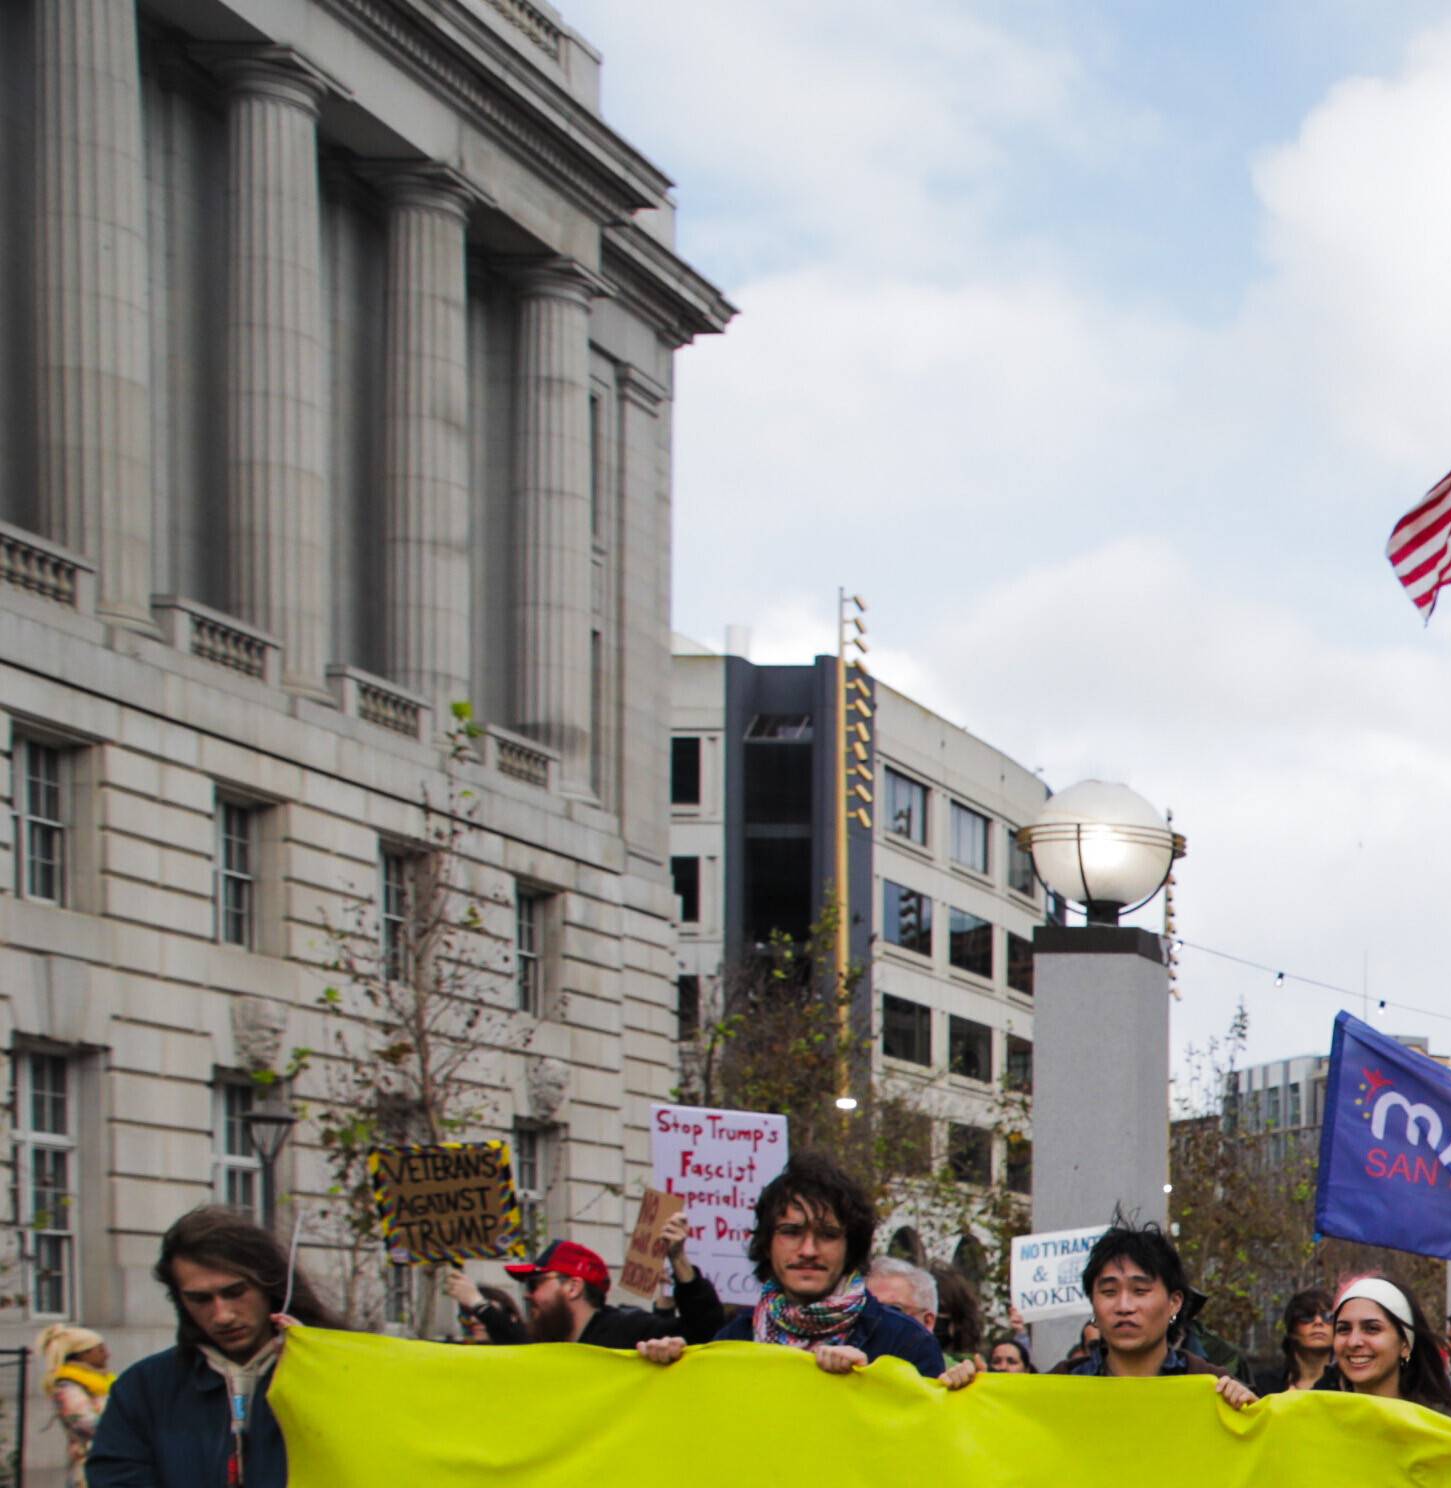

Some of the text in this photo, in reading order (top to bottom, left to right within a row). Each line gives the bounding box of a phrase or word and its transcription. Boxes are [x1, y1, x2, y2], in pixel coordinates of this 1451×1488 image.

[656, 1110, 779, 1152] Stop Trump's
[380, 1152, 497, 1184] VETERANS
[681, 1151, 756, 1183] Fascist
[1364, 1147, 1440, 1186] SAN
[396, 1186, 491, 1217] AGAINST
[666, 1177, 757, 1210] Iperialis
[399, 1215, 498, 1249] TRUMP
[1020, 1233, 1104, 1261] NO TYRANT
[1033, 1265, 1048, 1283] &
[1020, 1285, 1083, 1309] NO KIN
